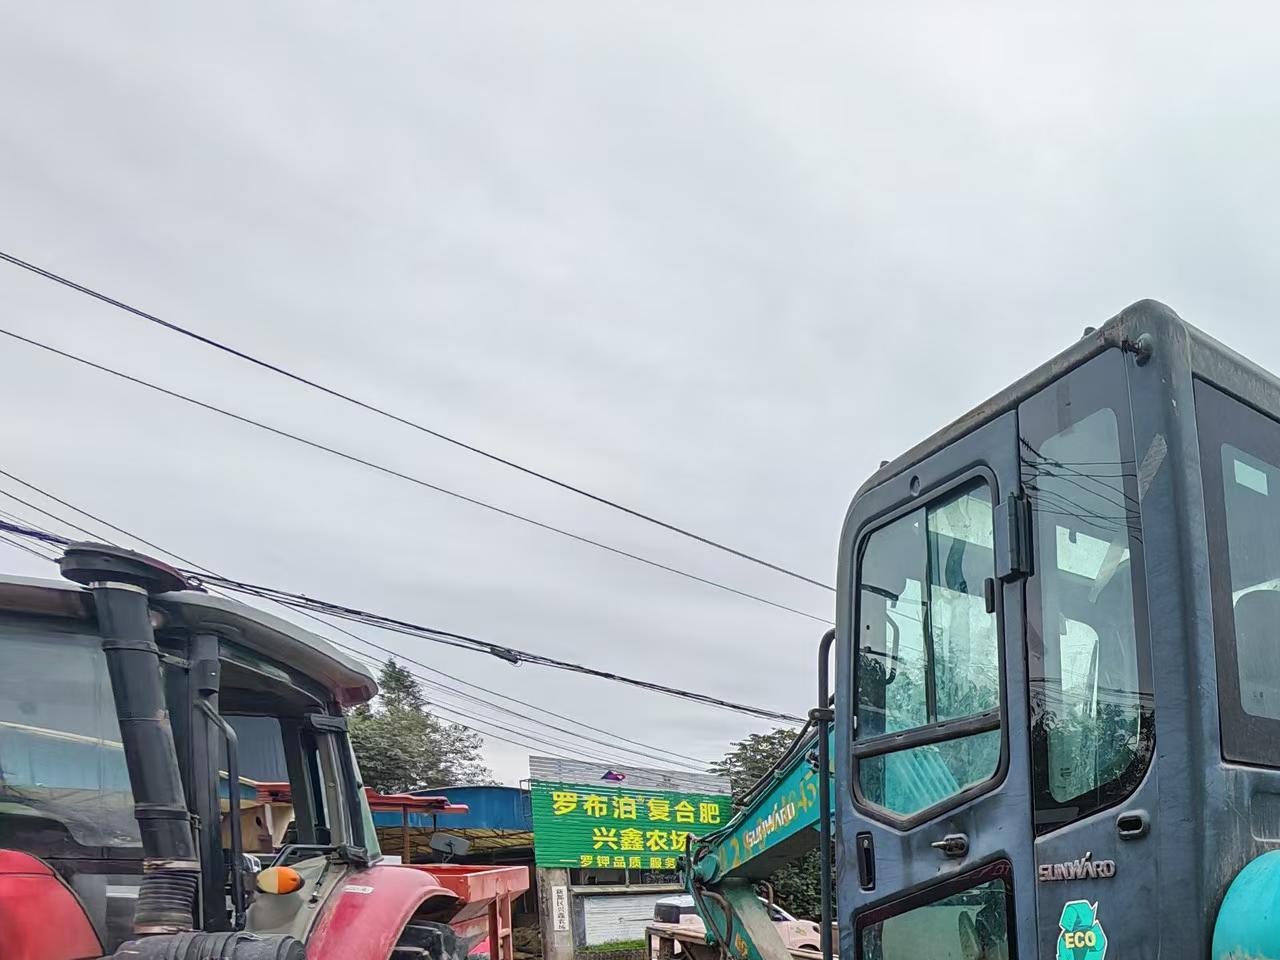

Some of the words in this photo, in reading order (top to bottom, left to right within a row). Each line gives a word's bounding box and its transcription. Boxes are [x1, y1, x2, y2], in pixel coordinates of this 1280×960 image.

[592, 826, 690, 852] 兴鑫农场
[1065, 932, 1097, 949] ECO
